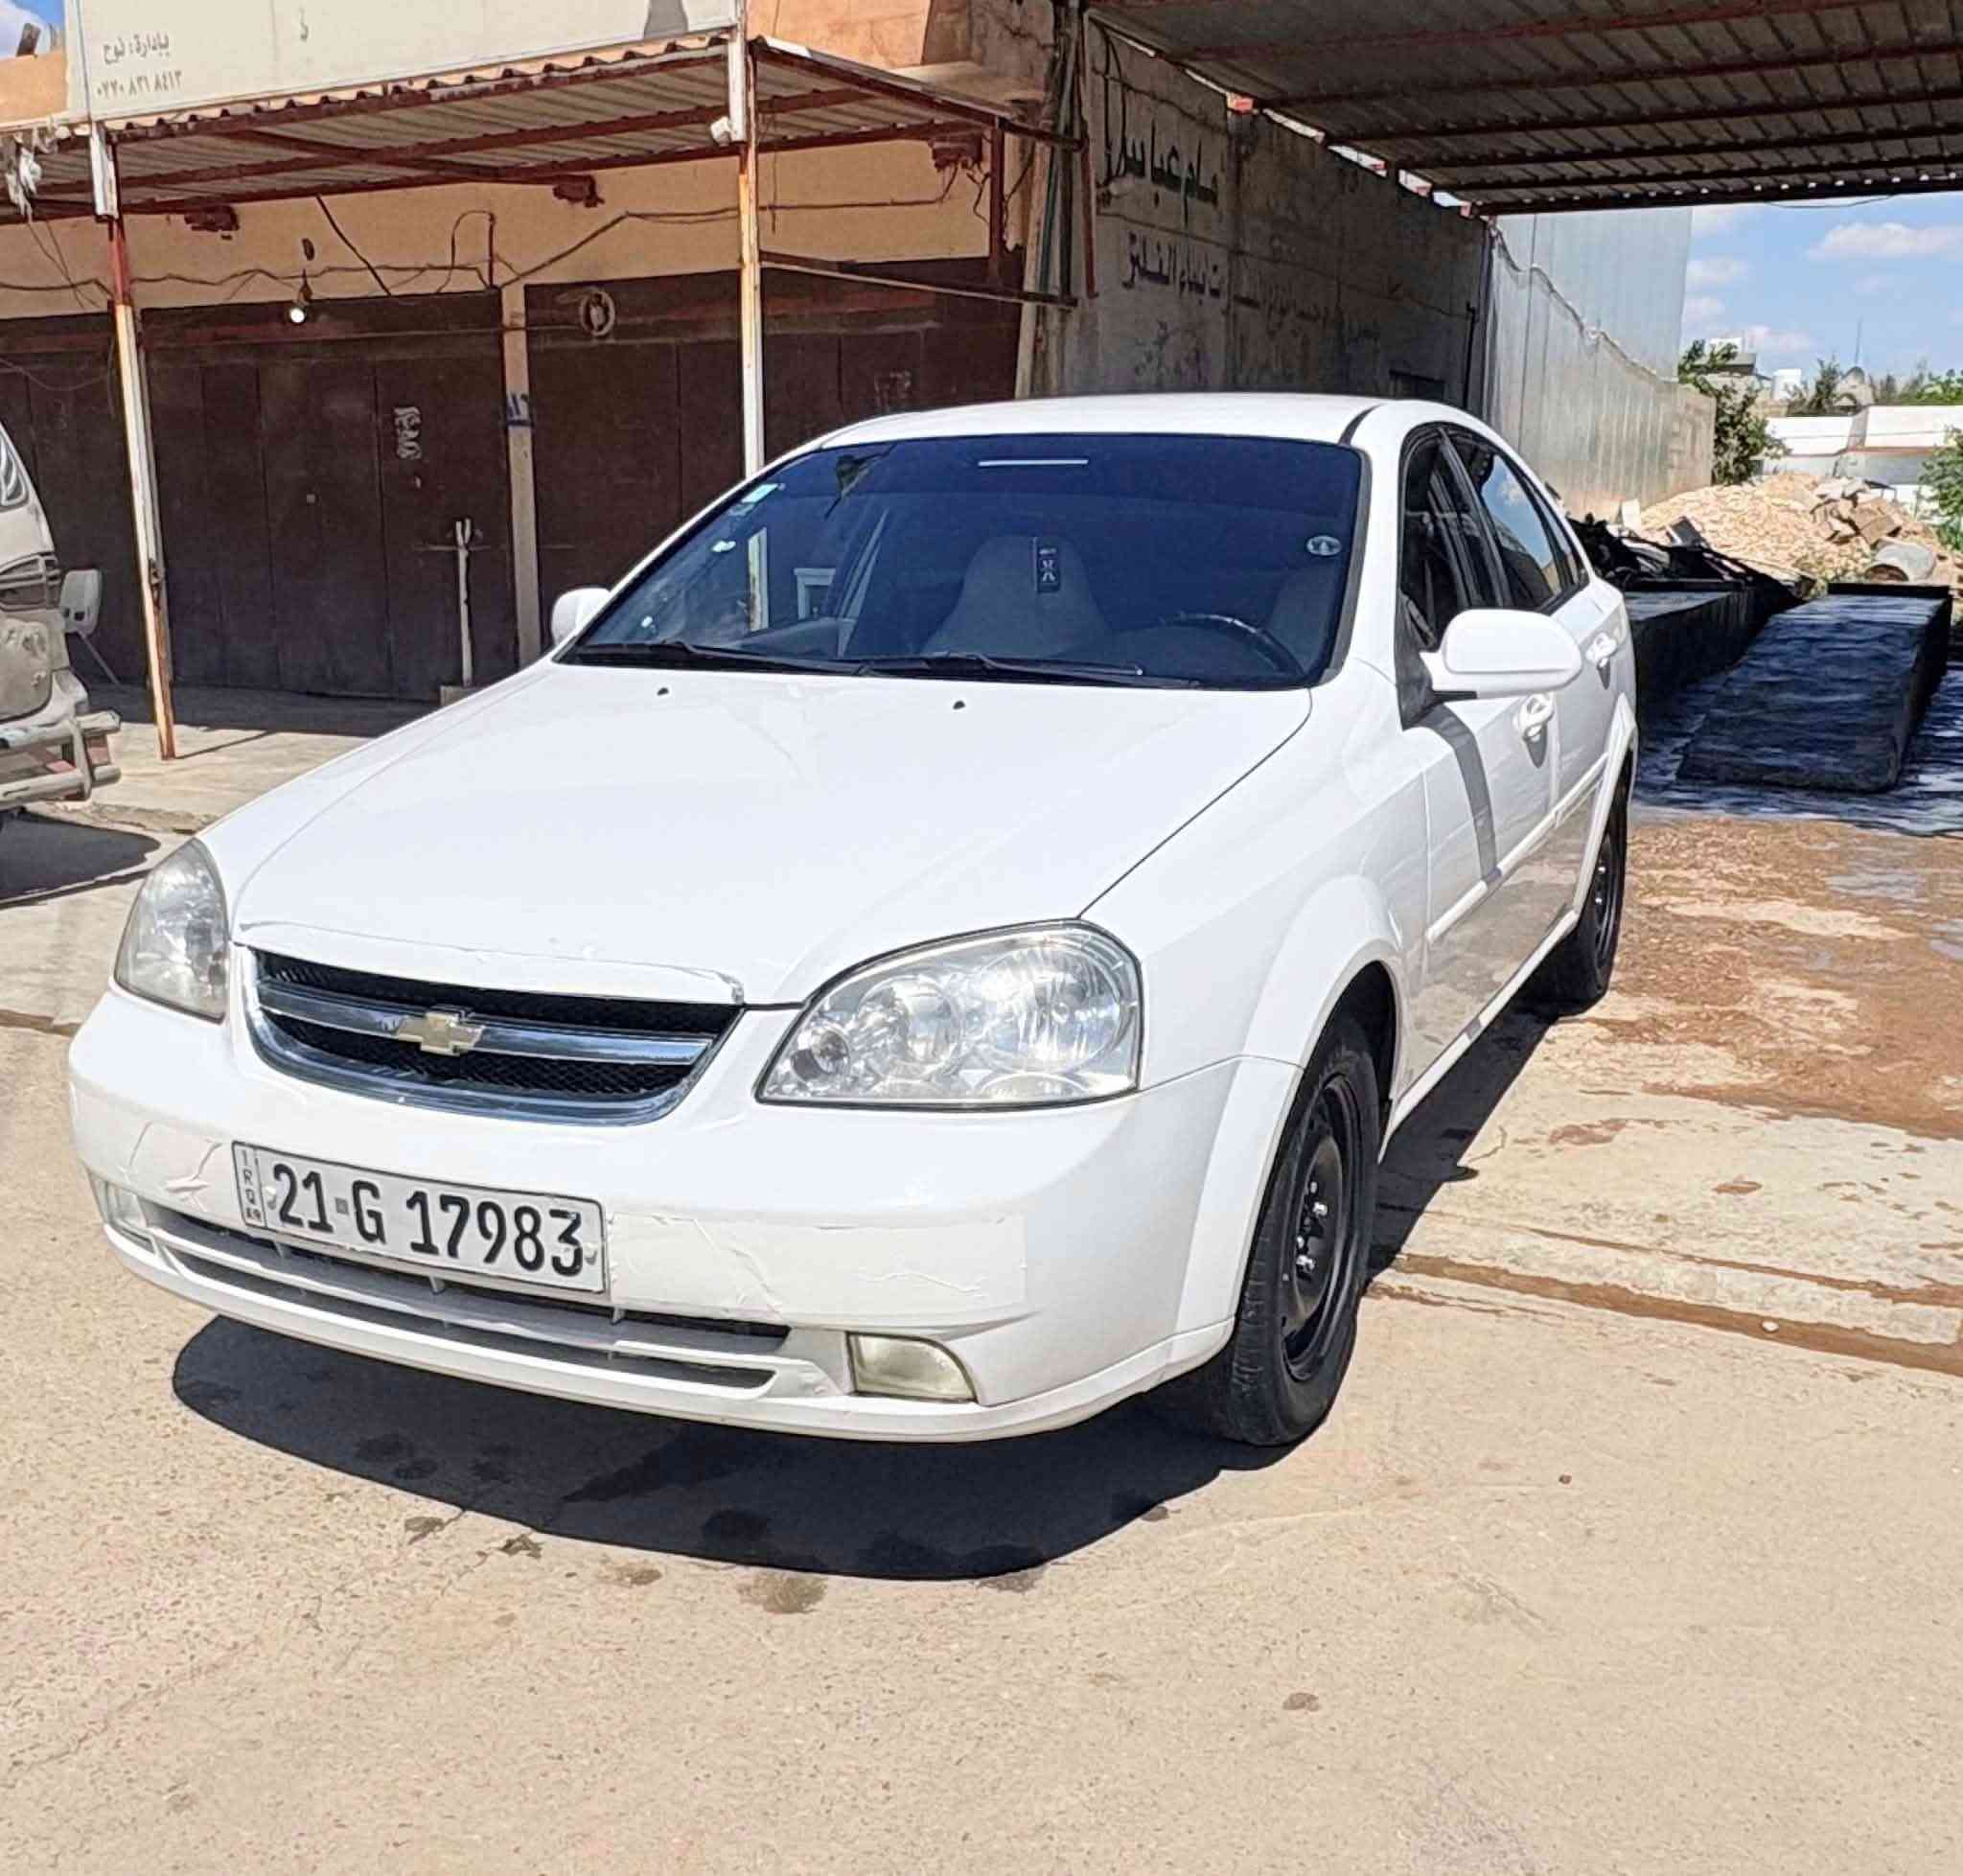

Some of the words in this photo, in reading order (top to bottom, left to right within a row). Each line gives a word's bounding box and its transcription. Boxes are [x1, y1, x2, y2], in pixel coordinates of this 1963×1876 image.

[273, 1163, 334, 1234] 21
[352, 1179, 386, 1245] G
[406, 1191, 583, 1277] 17983
